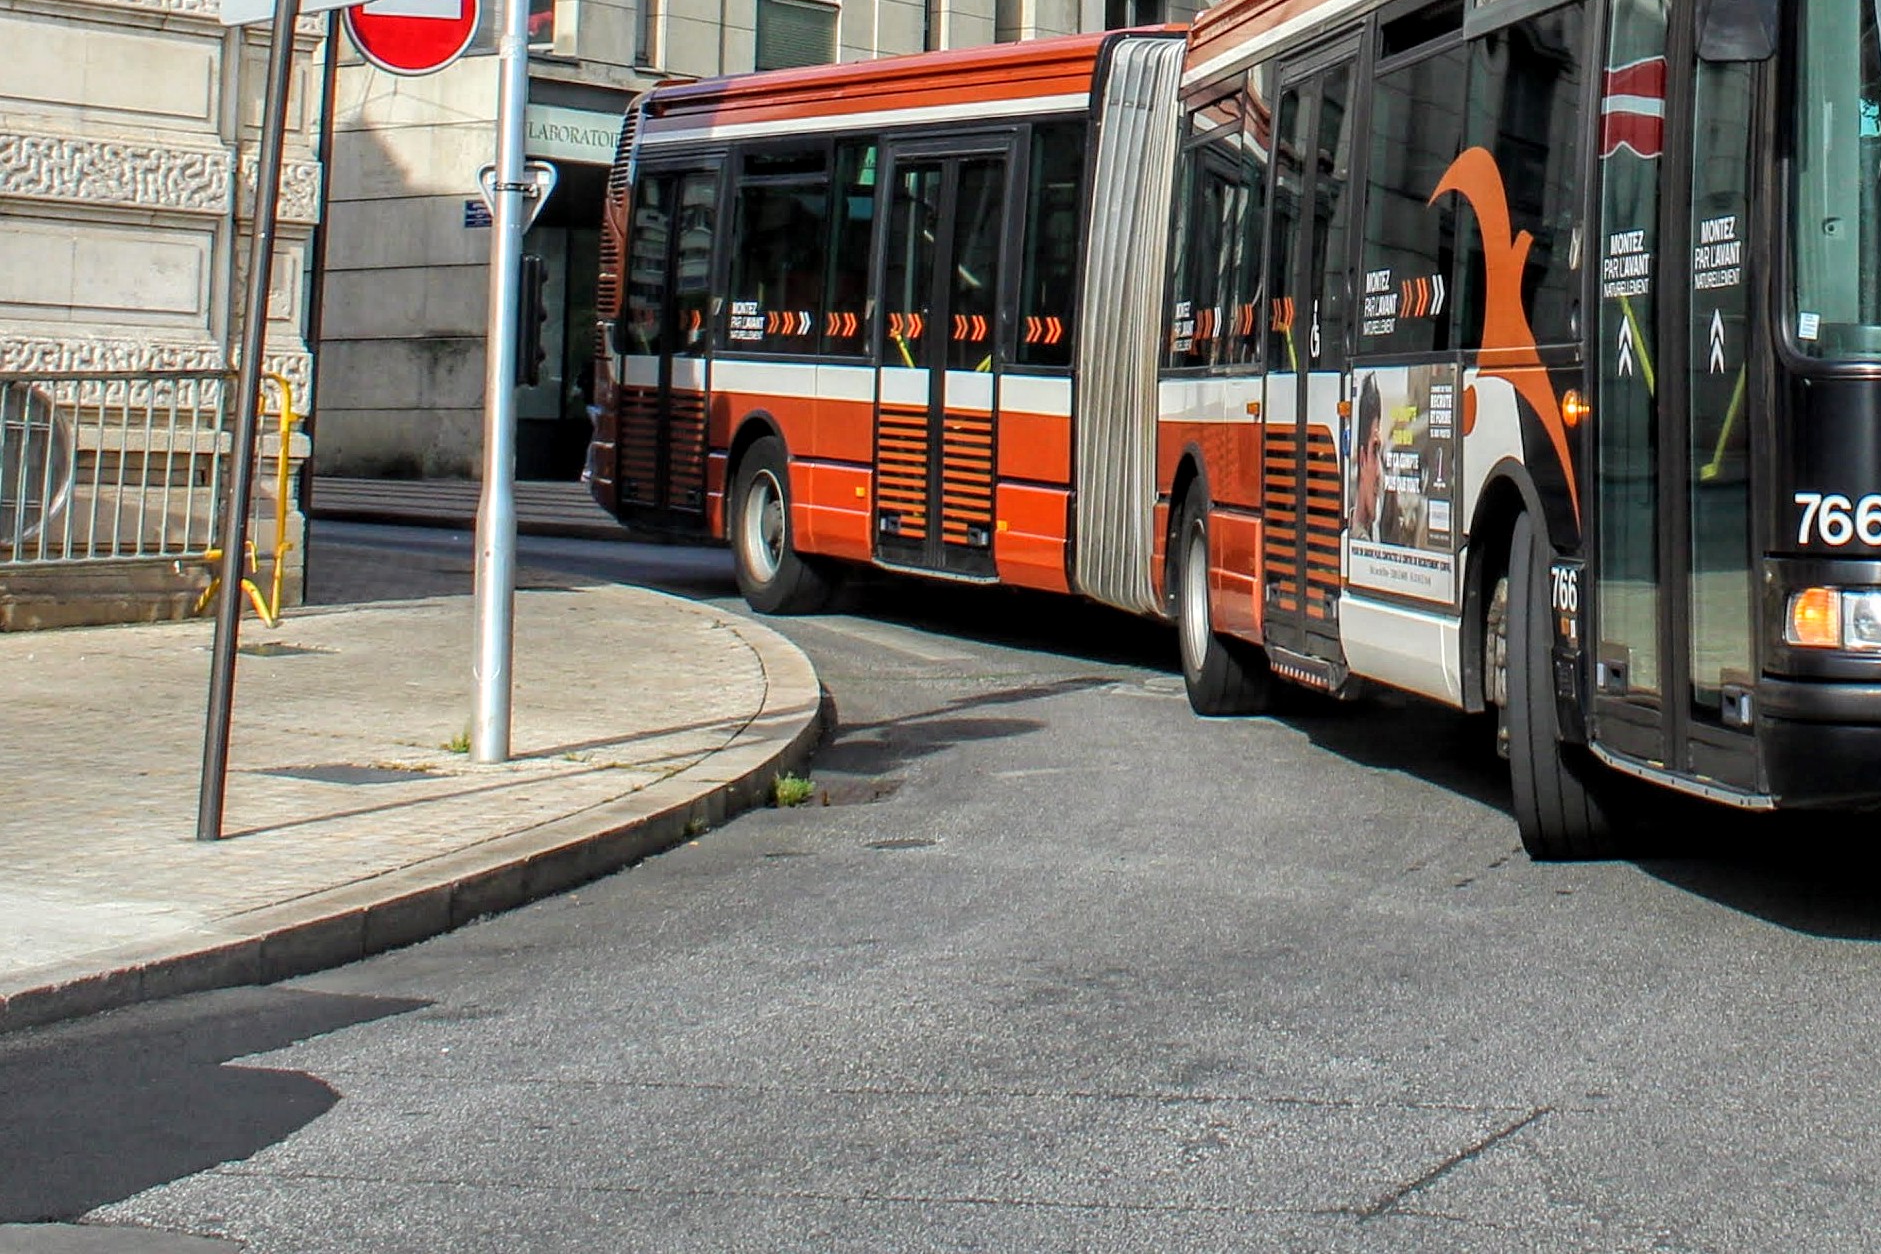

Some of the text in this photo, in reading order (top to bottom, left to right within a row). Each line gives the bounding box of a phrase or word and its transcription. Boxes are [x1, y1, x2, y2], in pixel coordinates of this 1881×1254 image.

[1610, 230, 1644, 256] MONTEZ
[1701, 216, 1736, 244] MONTEZ
[1604, 253, 1650, 280] PAR L'AVANT
[1695, 241, 1741, 270] PAR L'AVANT
[1366, 269, 1391, 293] MONTEZ
[1551, 566, 1578, 612] 766
